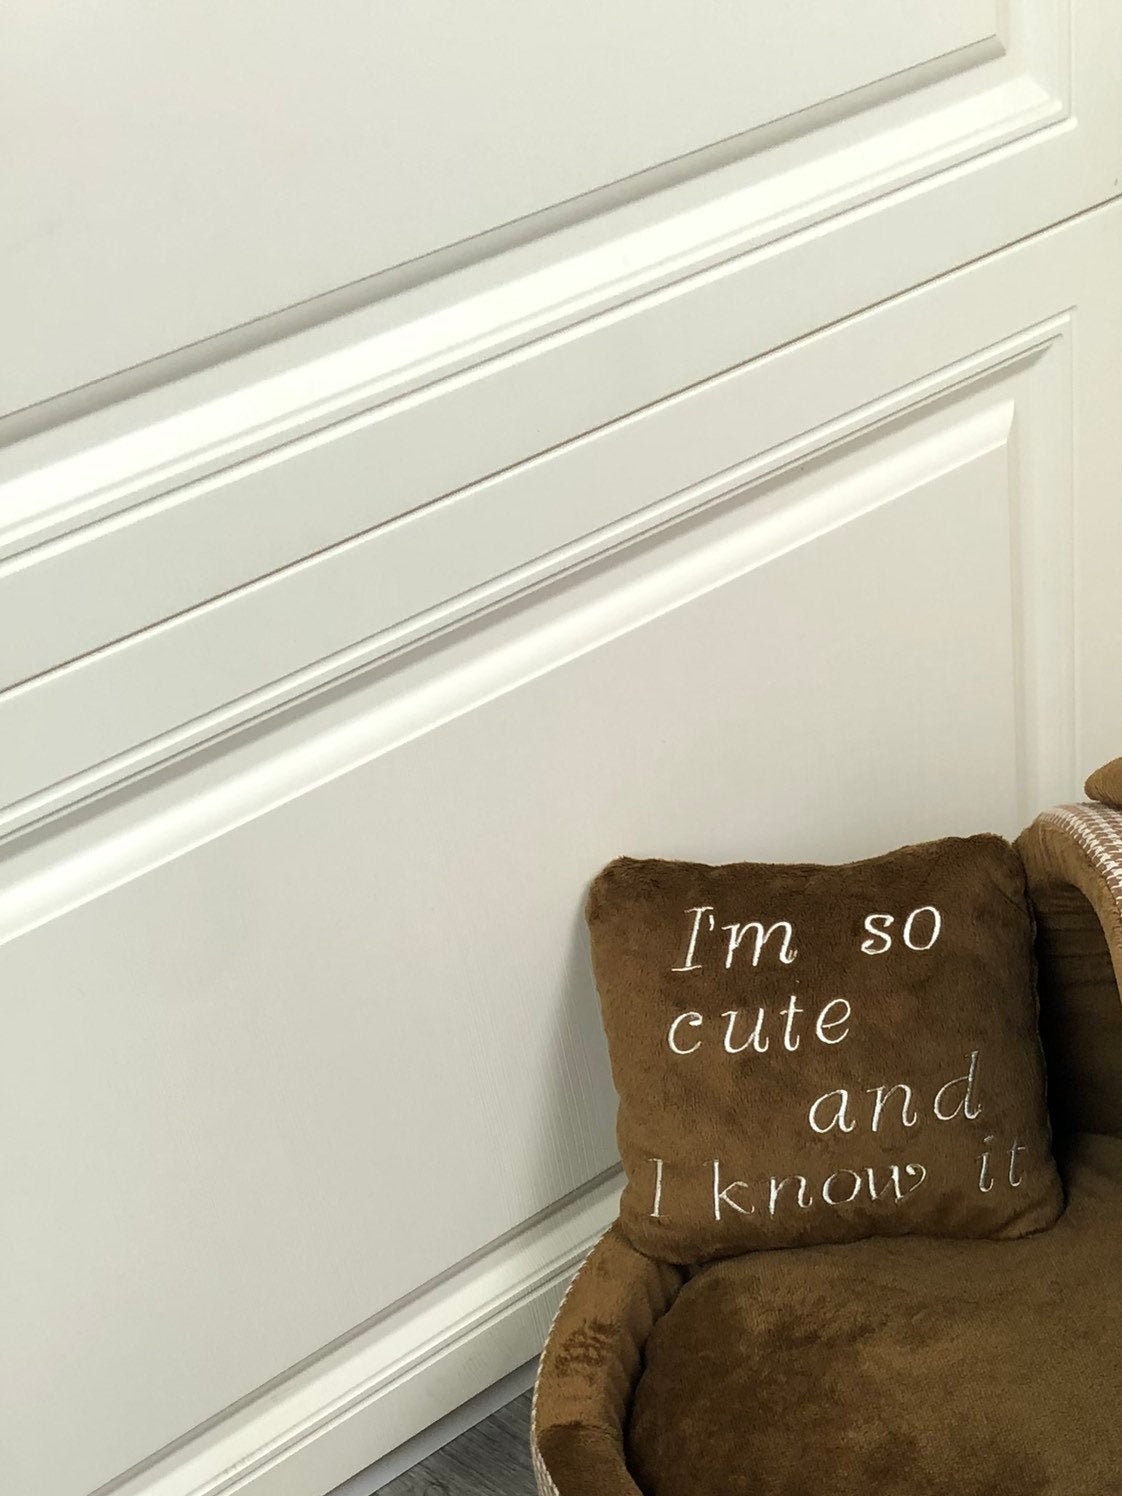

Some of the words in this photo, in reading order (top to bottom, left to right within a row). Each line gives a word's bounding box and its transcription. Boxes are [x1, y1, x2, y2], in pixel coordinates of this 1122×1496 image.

[671, 906, 797, 971] I'm
[861, 906, 941, 954] so
[667, 995, 851, 1054] cute
[808, 1050, 981, 1133] and
[646, 1157, 665, 1218] I
[702, 1157, 927, 1221] know
[976, 1135, 1026, 1192] it
